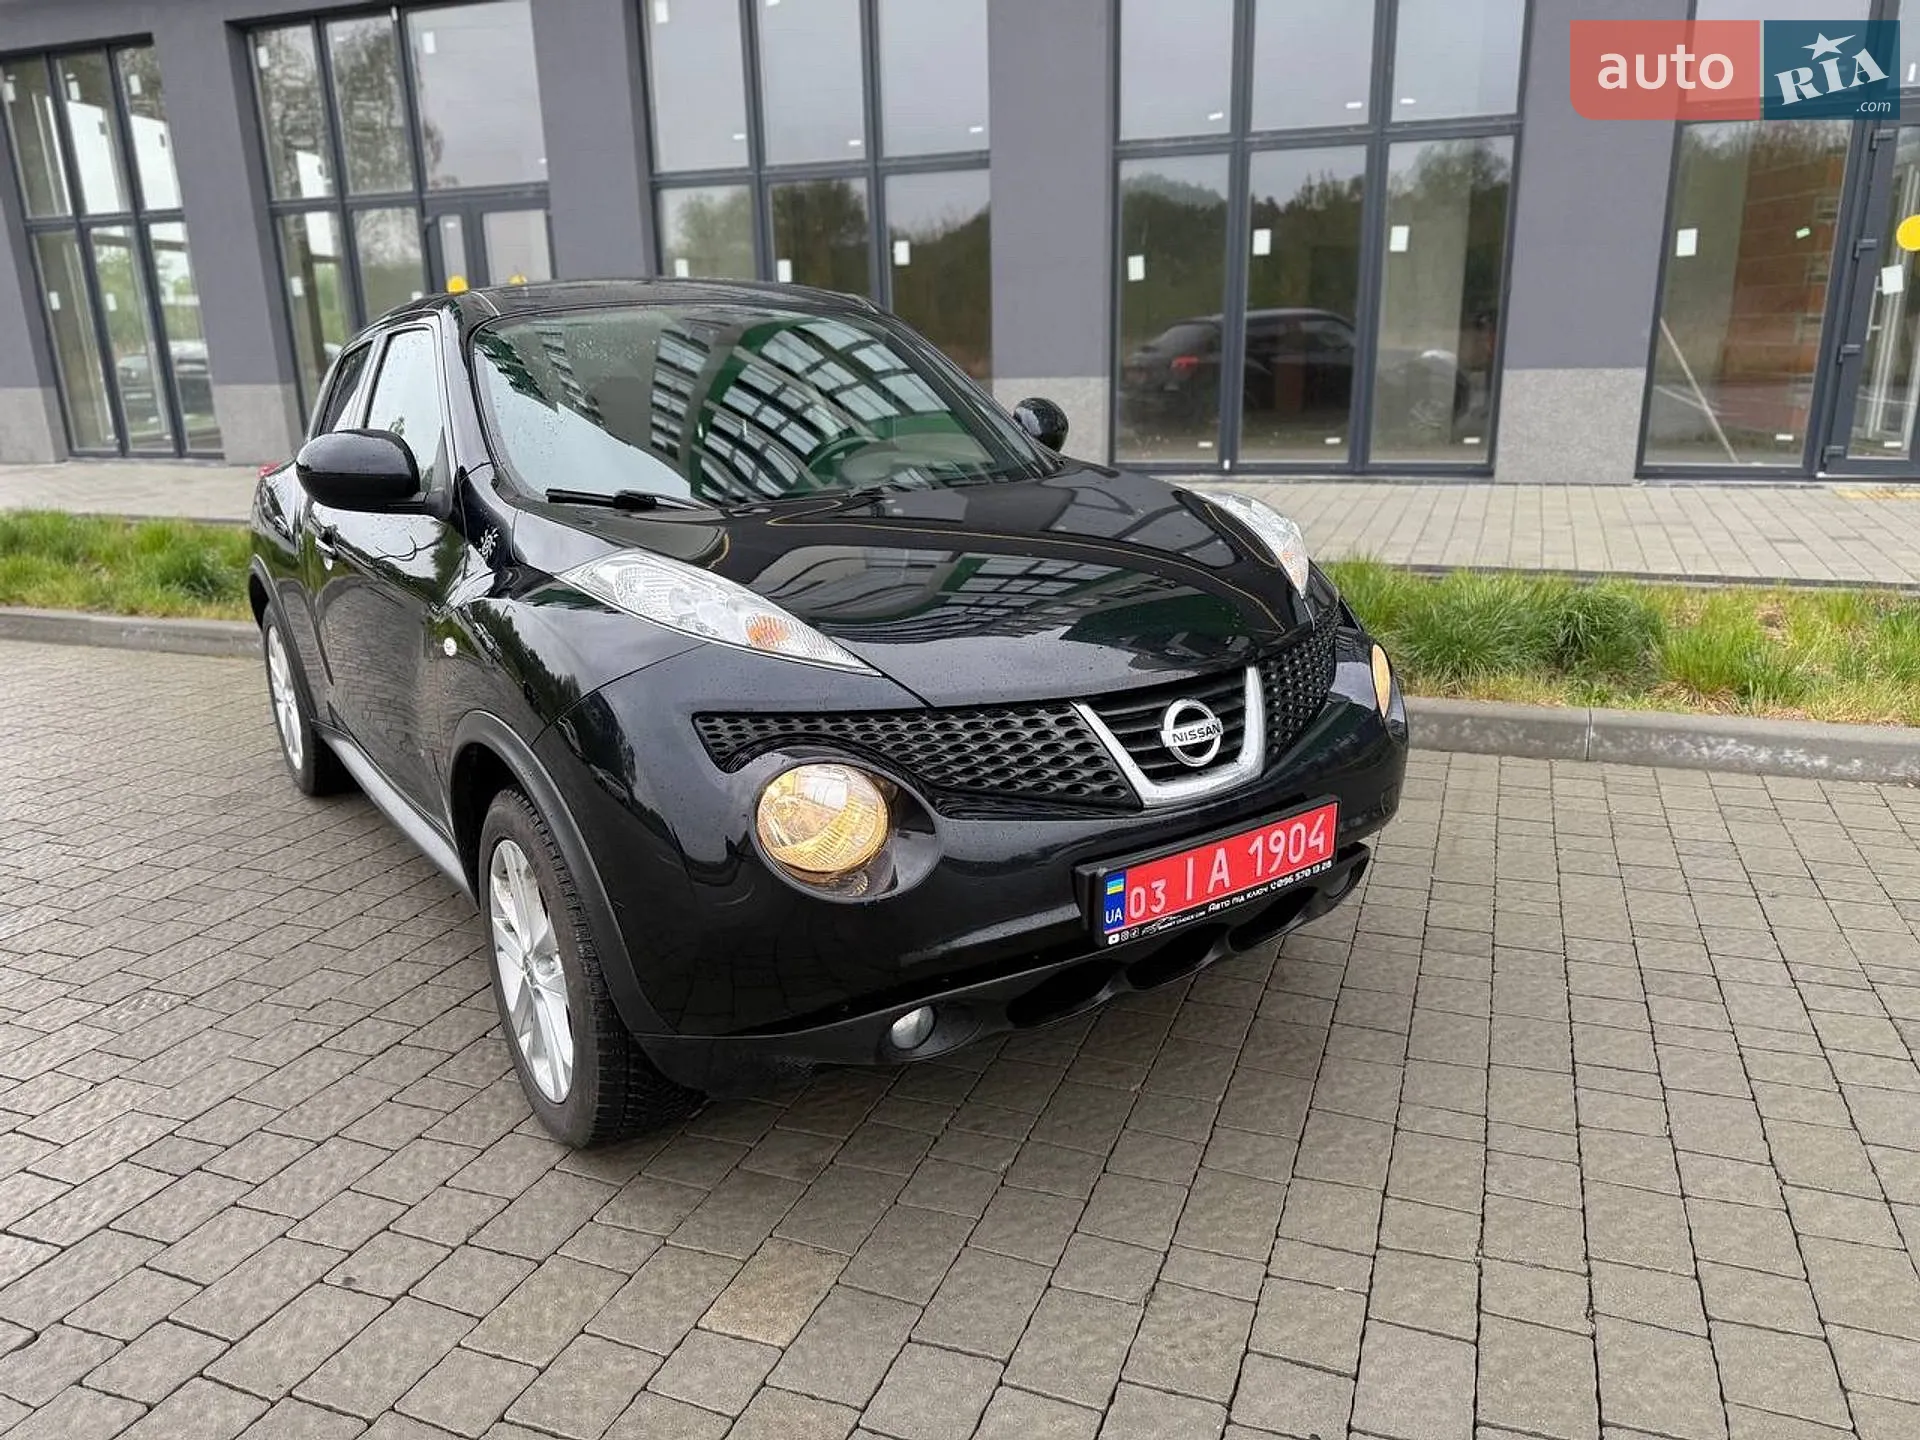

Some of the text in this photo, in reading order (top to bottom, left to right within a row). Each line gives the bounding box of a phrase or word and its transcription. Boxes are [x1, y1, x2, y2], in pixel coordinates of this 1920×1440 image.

[1172, 722, 1221, 743] NISSAN
[1129, 878, 1167, 919] 03
[1248, 813, 1326, 877] 1904
[1105, 907, 1123, 924] UA
